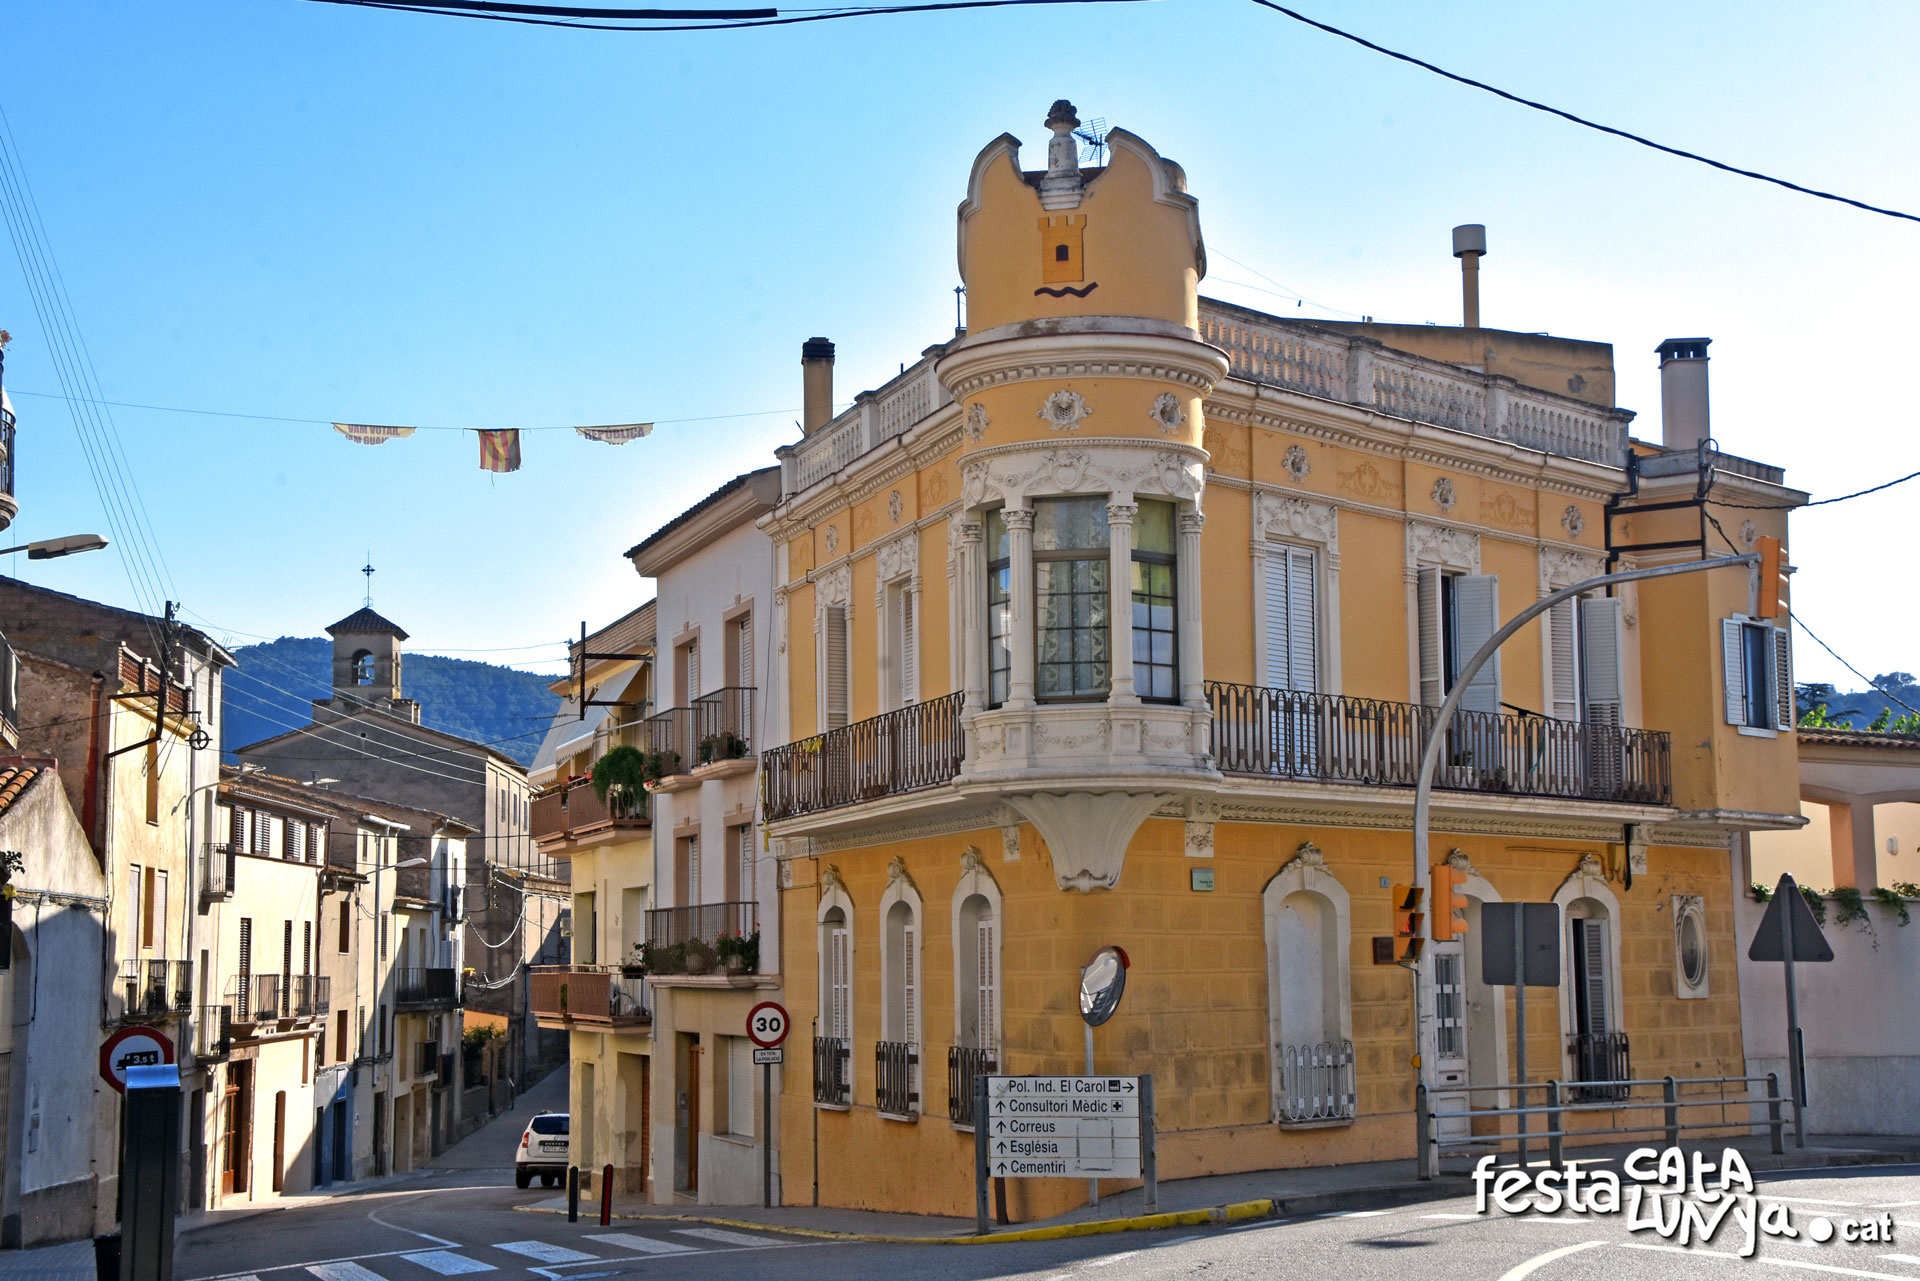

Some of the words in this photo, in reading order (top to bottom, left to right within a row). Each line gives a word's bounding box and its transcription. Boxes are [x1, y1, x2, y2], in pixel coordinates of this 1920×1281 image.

[348, 424, 368, 434] VAM
[756, 1017, 780, 1032] 30
[1009, 1080, 1030, 1092] Pol.
[1034, 1080, 1056, 1093] Ind.
[1060, 1080, 1071, 1092] El
[1075, 1080, 1106, 1092] Carol
[1009, 1099, 1068, 1112] Consultori
[1072, 1099, 1108, 1112] Mèdic
[1010, 1119, 1056, 1133] Correus
[1010, 1140, 1058, 1156] Església
[1010, 1160, 1066, 1173] Cementiri
